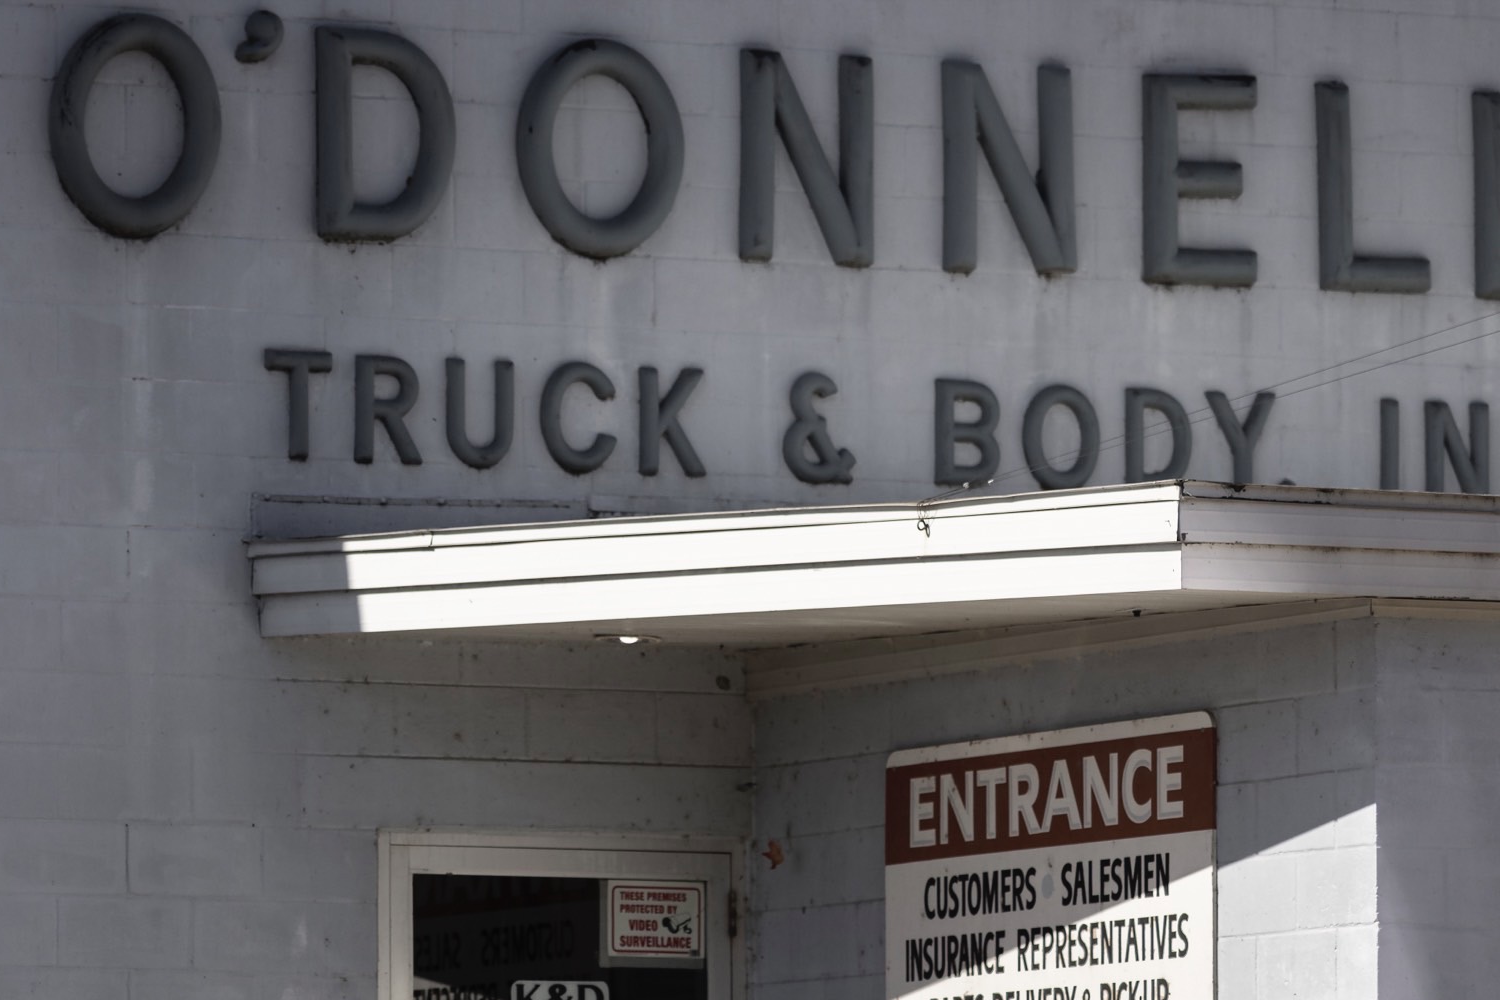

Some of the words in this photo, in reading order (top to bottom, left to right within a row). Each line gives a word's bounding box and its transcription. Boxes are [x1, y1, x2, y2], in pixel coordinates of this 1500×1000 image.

[263, 348, 708, 479] TRUCK
[781, 371, 856, 485] &
[932, 375, 1297, 490] BODY
[909, 744, 1184, 849] ENTRANCE
[619, 891, 645, 901] THESE
[647, 892, 687, 902] PREMISES
[924, 866, 1037, 920] CUSTOMERS
[1061, 852, 1171, 906] SALESMEN
[619, 904, 665, 914] PROTECTED
[667, 905, 677, 914] BY
[628, 919, 658, 931] VIDEO
[619, 935, 692, 948] SURVEILLANCE
[905, 930, 1005, 982] INSURANCE
[1017, 913, 1190, 972] REPRESENTATIVES
